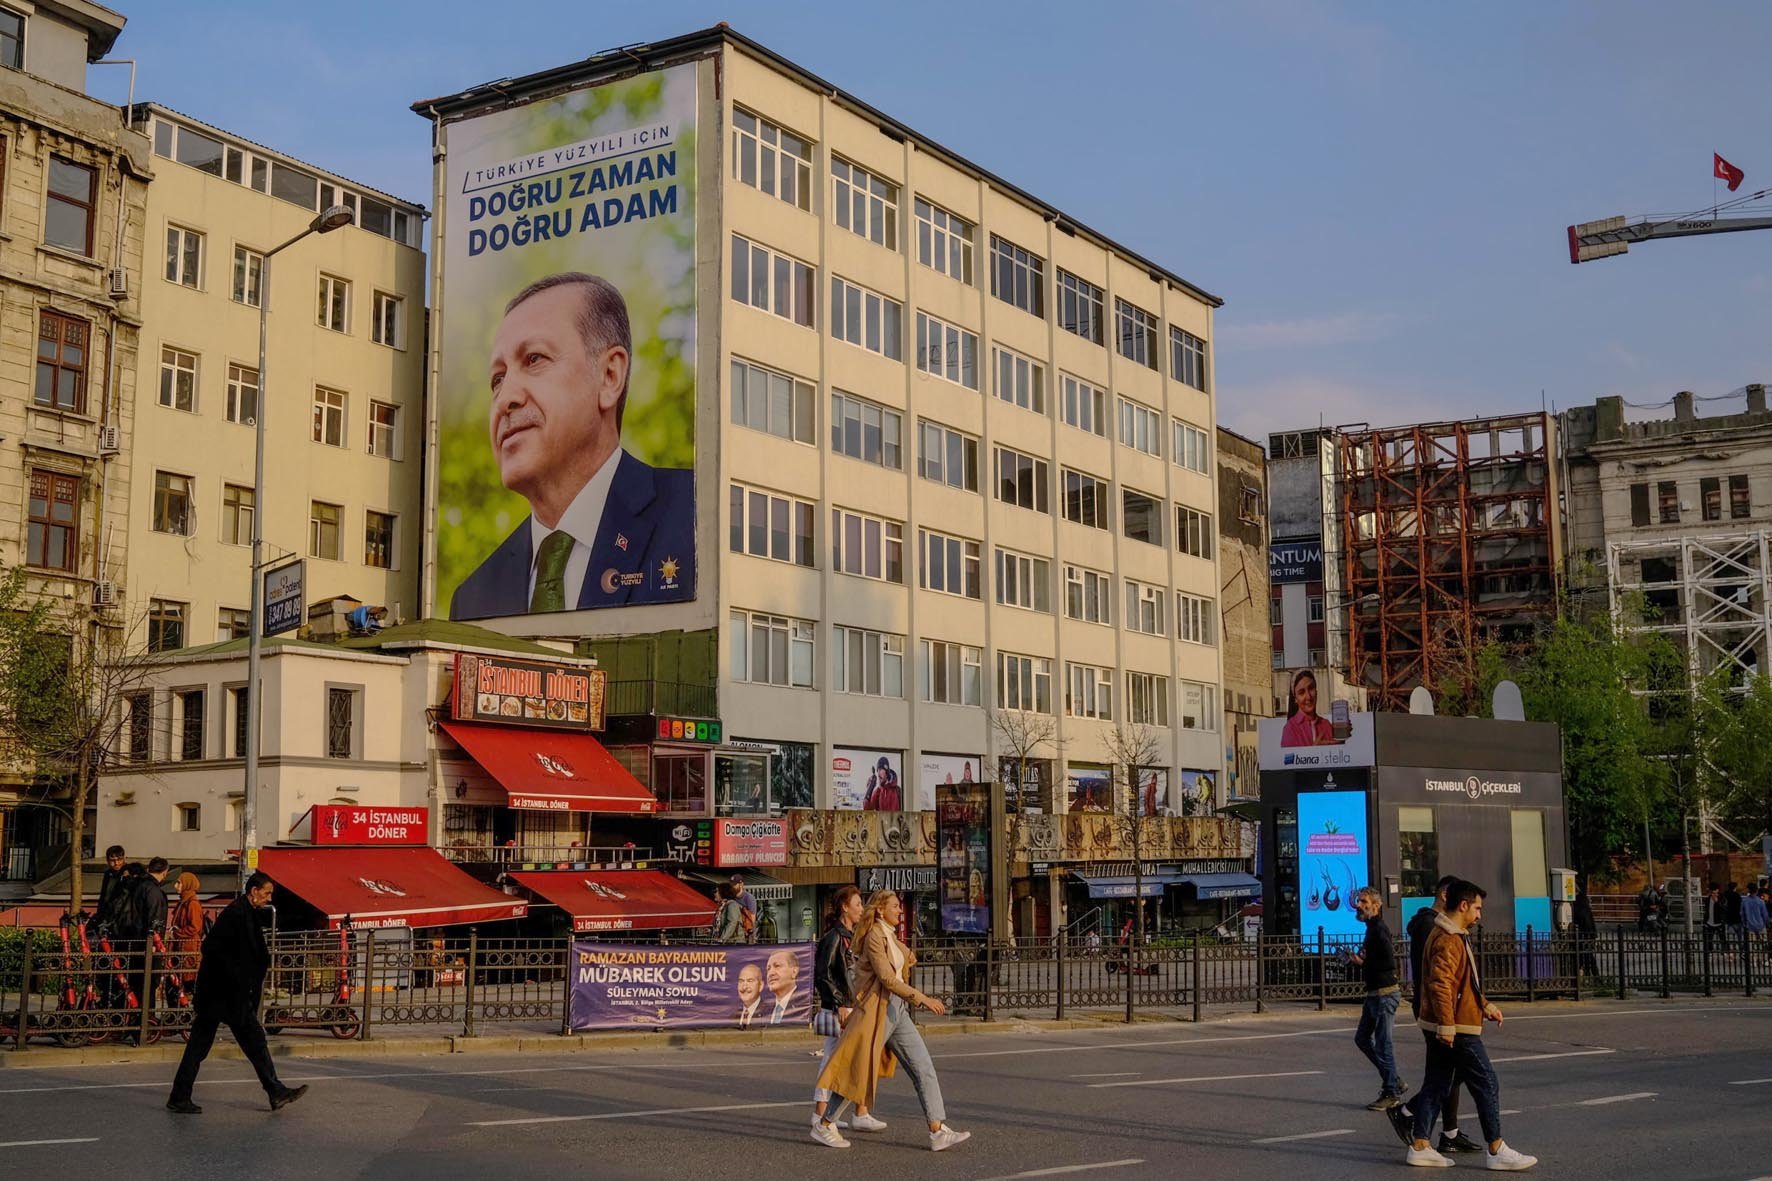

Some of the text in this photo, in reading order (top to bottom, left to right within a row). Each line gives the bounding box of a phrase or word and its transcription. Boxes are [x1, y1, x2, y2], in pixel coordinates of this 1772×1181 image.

[475, 125, 670, 183] TÜRKİYE YÜZYILI İÇİN
[469, 150, 677, 222] DOĞRU ZAMAN
[468, 184, 677, 257] DOĞRU ADAM
[1283, 567, 1305, 577] TIME
[478, 660, 589, 703] İSTANBUL DÖNER
[1295, 751, 1351, 766] bianca stella
[1425, 779, 1521, 796] İSTANBUL ÇİÇEKLERİ
[513, 798, 569, 809] 34 İSTANBUL DÖNER
[352, 809, 422, 825] 34 İSTANBUL
[368, 824, 407, 839] DÖNER
[725, 822, 781, 838] Damga Çiğköfte
[1140, 863, 1160, 876] URAT
[885, 869, 913, 891] ATLAS
[348, 920, 382, 930] STANBUL
[383, 918, 407, 928] DÖNER
[585, 919, 613, 930] İSTANBUL
[613, 919, 633, 929] DÖNER
[579, 951, 727, 965] RAMAZAN BAYRAMINIZ
[579, 965, 726, 984] MÜBAREK OLSUN
[606, 985, 699, 998] SÜLEYMAN SOYLU
